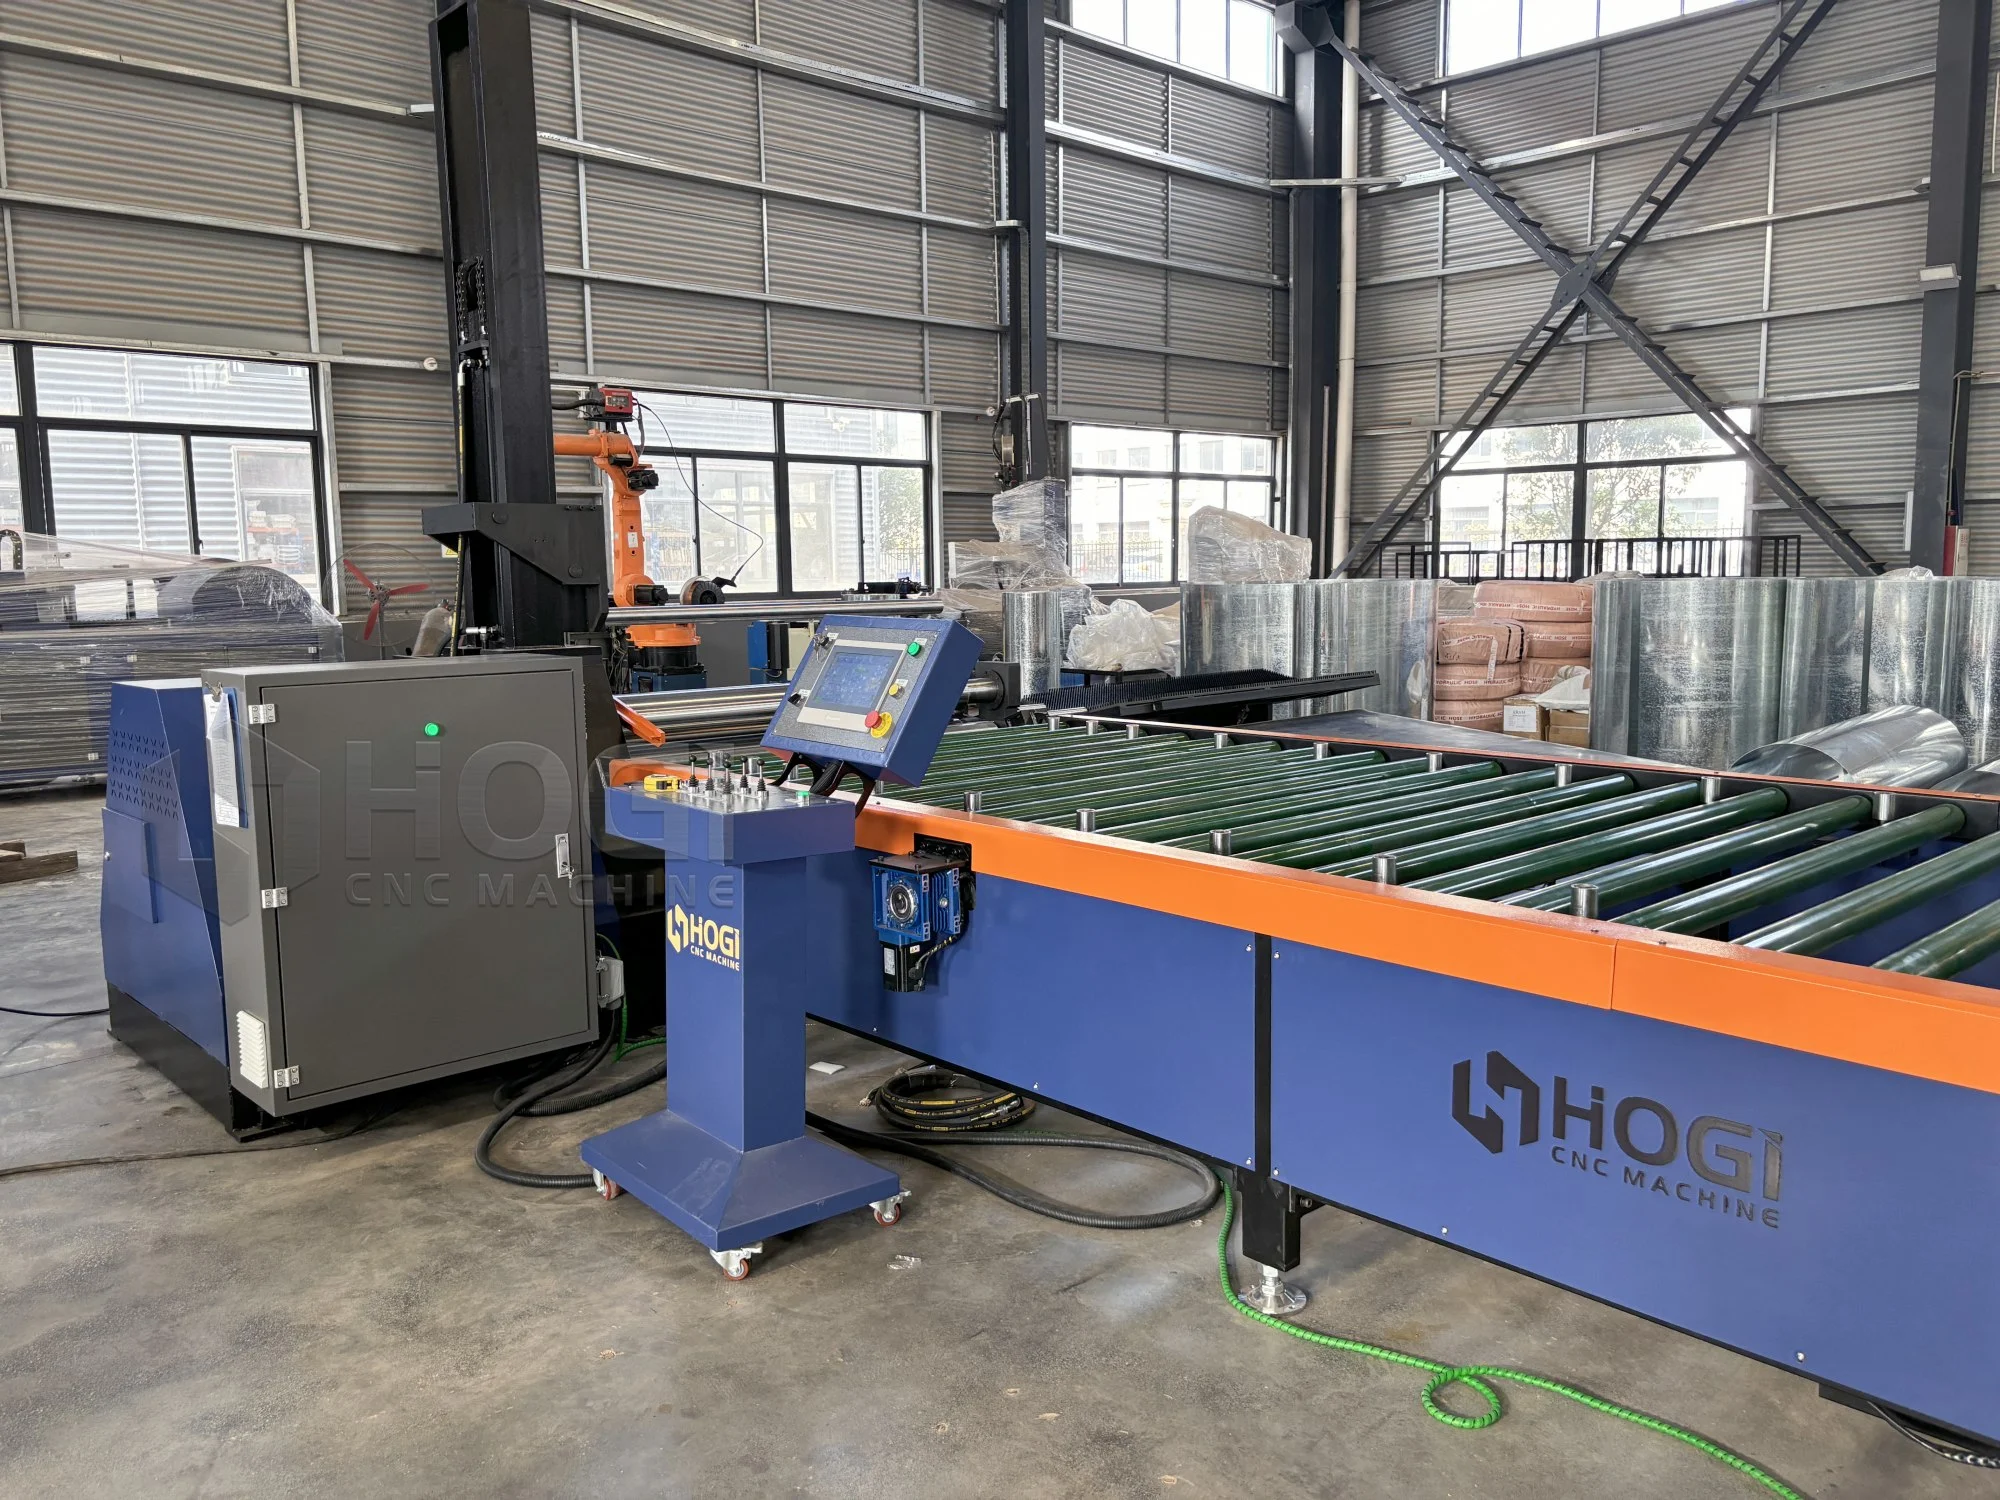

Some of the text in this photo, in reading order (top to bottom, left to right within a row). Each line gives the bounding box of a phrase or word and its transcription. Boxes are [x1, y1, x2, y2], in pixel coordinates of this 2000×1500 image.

[690, 945, 740, 972] CNC MACHINE
[1551, 1145, 1780, 1229] CNC MACHINE
